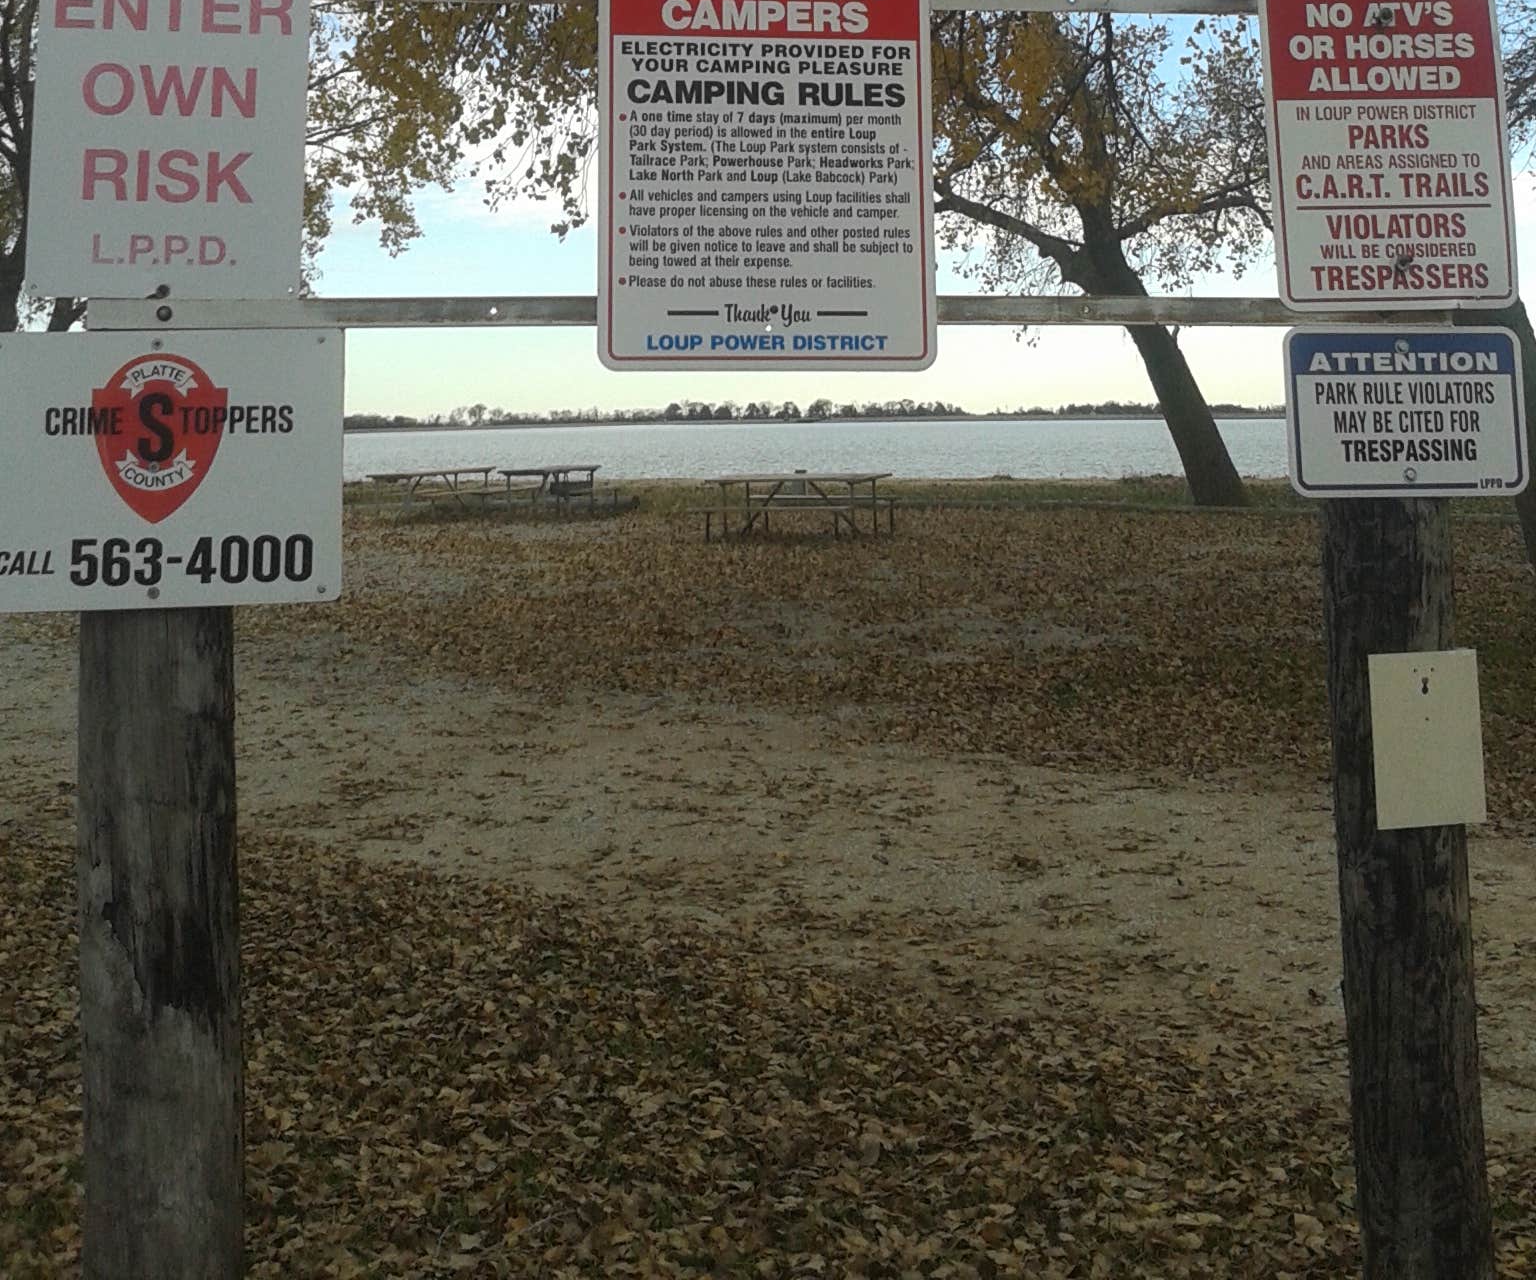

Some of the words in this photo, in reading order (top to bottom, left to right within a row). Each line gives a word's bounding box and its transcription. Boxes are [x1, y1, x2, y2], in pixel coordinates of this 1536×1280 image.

[1306, 2, 1352, 27] NO
[621, 41, 753, 56] ELECTRICITY
[761, 43, 863, 58] PROVIDED
[871, 45, 910, 59] FOR
[1289, 35, 1334, 60] OR
[1345, 32, 1474, 59] HORSES
[631, 57, 688, 72] YOUR
[696, 59, 790, 74] CAMPING
[798, 60, 902, 75] PLEASURE
[1309, 65, 1460, 91] ALLOWED
[82, 62, 257, 118] OWN
[627, 78, 784, 105] CAMPING
[798, 82, 905, 107] RULES
[1296, 106, 1309, 120] IN
[1315, 105, 1351, 120] LOUP
[1357, 105, 1408, 120] POWER
[1413, 104, 1476, 119] DISTRICT
[1348, 123, 1429, 149] PARKS
[1301, 155, 1330, 169] AND
[1336, 154, 1382, 169] AREAS
[1388, 153, 1457, 168] ASSIGNED
[1461, 152, 1479, 167] TO
[82, 148, 252, 203] RISK
[629, 168, 656, 180] Lake
[661, 168, 693, 181] North
[697, 169, 722, 181] Park
[726, 169, 746, 181] and
[750, 169, 777, 184] Loup
[782, 170, 811, 183] (Lake
[815, 170, 864, 185] Babcock)
[869, 171, 897, 185] Park)
[1295, 173, 1390, 199] C.A.R.T.
[1398, 171, 1488, 197] TRAILS
[1326, 212, 1465, 239] VIOLATORS
[92, 233, 236, 265] L.P.P.D.
[1319, 244, 1356, 259] WILL
[1361, 243, 1380, 258] BE
[1385, 242, 1475, 259] CONSIDERED
[629, 254, 658, 269] being
[662, 255, 696, 266] towed
[700, 255, 711, 266] at
[714, 255, 739, 267] their
[628, 275, 666, 287] Please
[670, 274, 683, 287] do
[687, 275, 705, 287] not
[709, 275, 742, 287] abuse
[746, 275, 776, 288] these
[780, 275, 807, 288] rules
[811, 278, 822, 287] or
[1310, 261, 1488, 290] TRESPASSERS
[724, 303, 770, 322] Thank
[781, 303, 812, 327] You
[647, 334, 702, 350] LOUP
[710, 334, 784, 350] POWER
[793, 334, 887, 350] DISTRICT
[1309, 351, 1497, 371] ATTENTION
[131, 365, 186, 383] PLATTE
[1315, 382, 1357, 404] PARK
[1363, 382, 1403, 404] RULE
[1408, 381, 1494, 404] VIOLATORS
[45, 407, 122, 436] CRIME
[1333, 410, 1366, 433] MAY
[1373, 410, 1393, 433] BE
[1398, 410, 1443, 433] CITED
[1450, 410, 1479, 432] FOR
[1341, 438, 1476, 462] TRESPASSING
[124, 468, 185, 488] COUNTY
[70, 533, 312, 586] 563-4000
